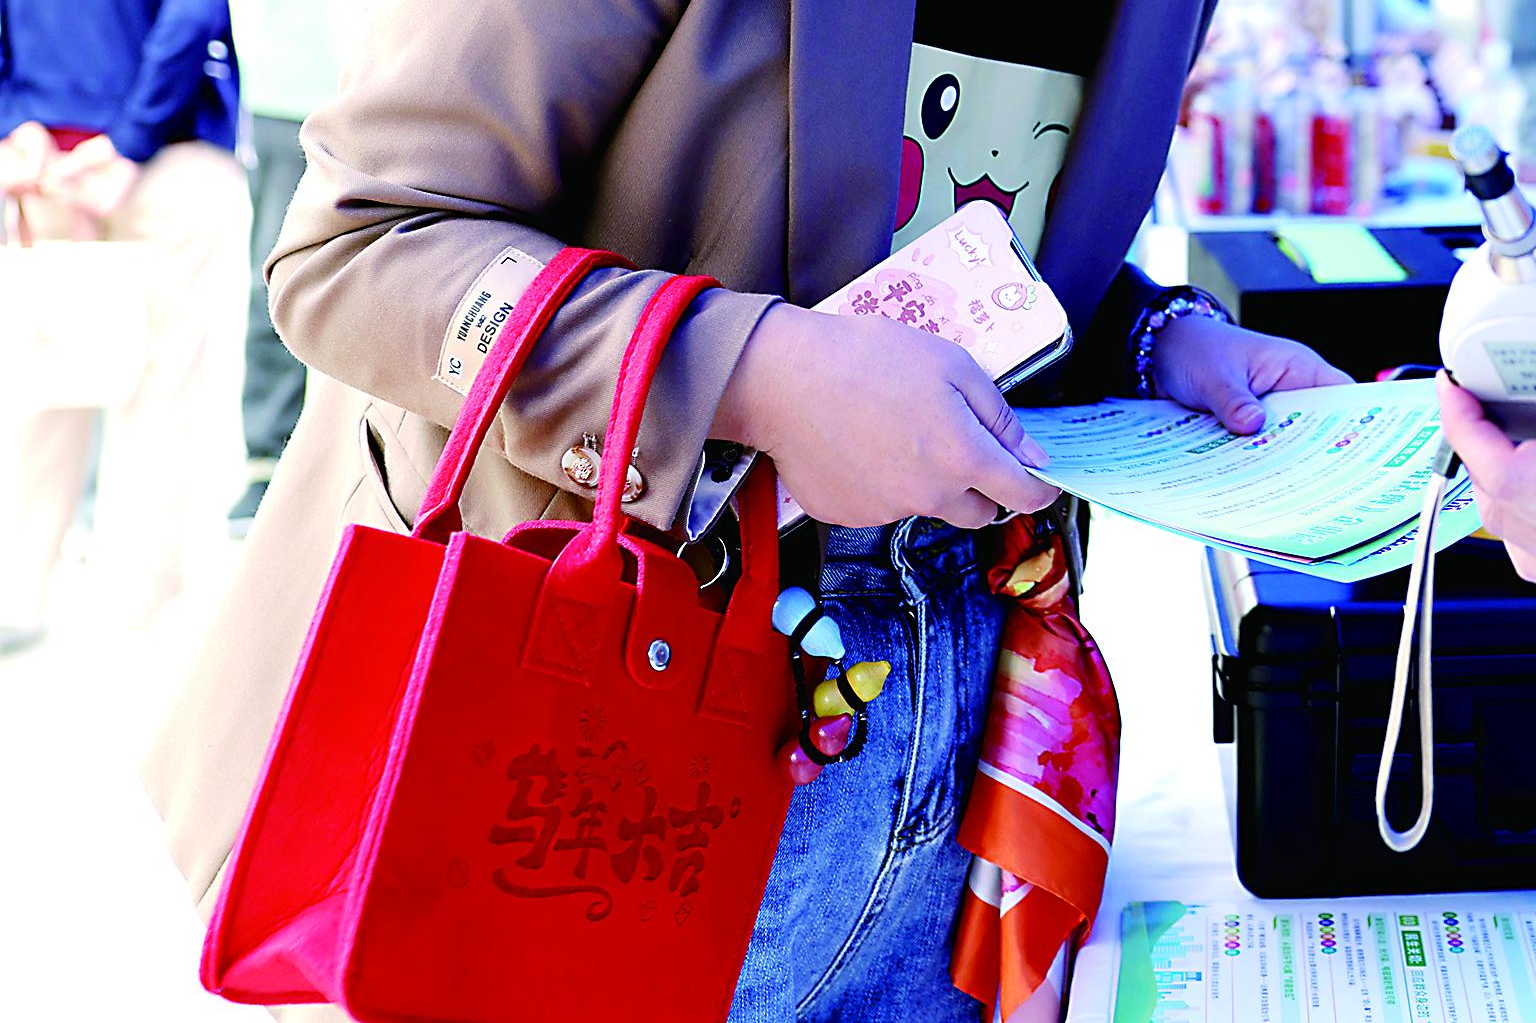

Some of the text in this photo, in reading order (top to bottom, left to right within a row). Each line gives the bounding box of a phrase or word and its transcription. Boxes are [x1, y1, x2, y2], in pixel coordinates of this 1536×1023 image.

[953, 229, 987, 267] Lucky!
[456, 290, 492, 342] YUANCHUANG
[476, 301, 514, 355] DESIGN
